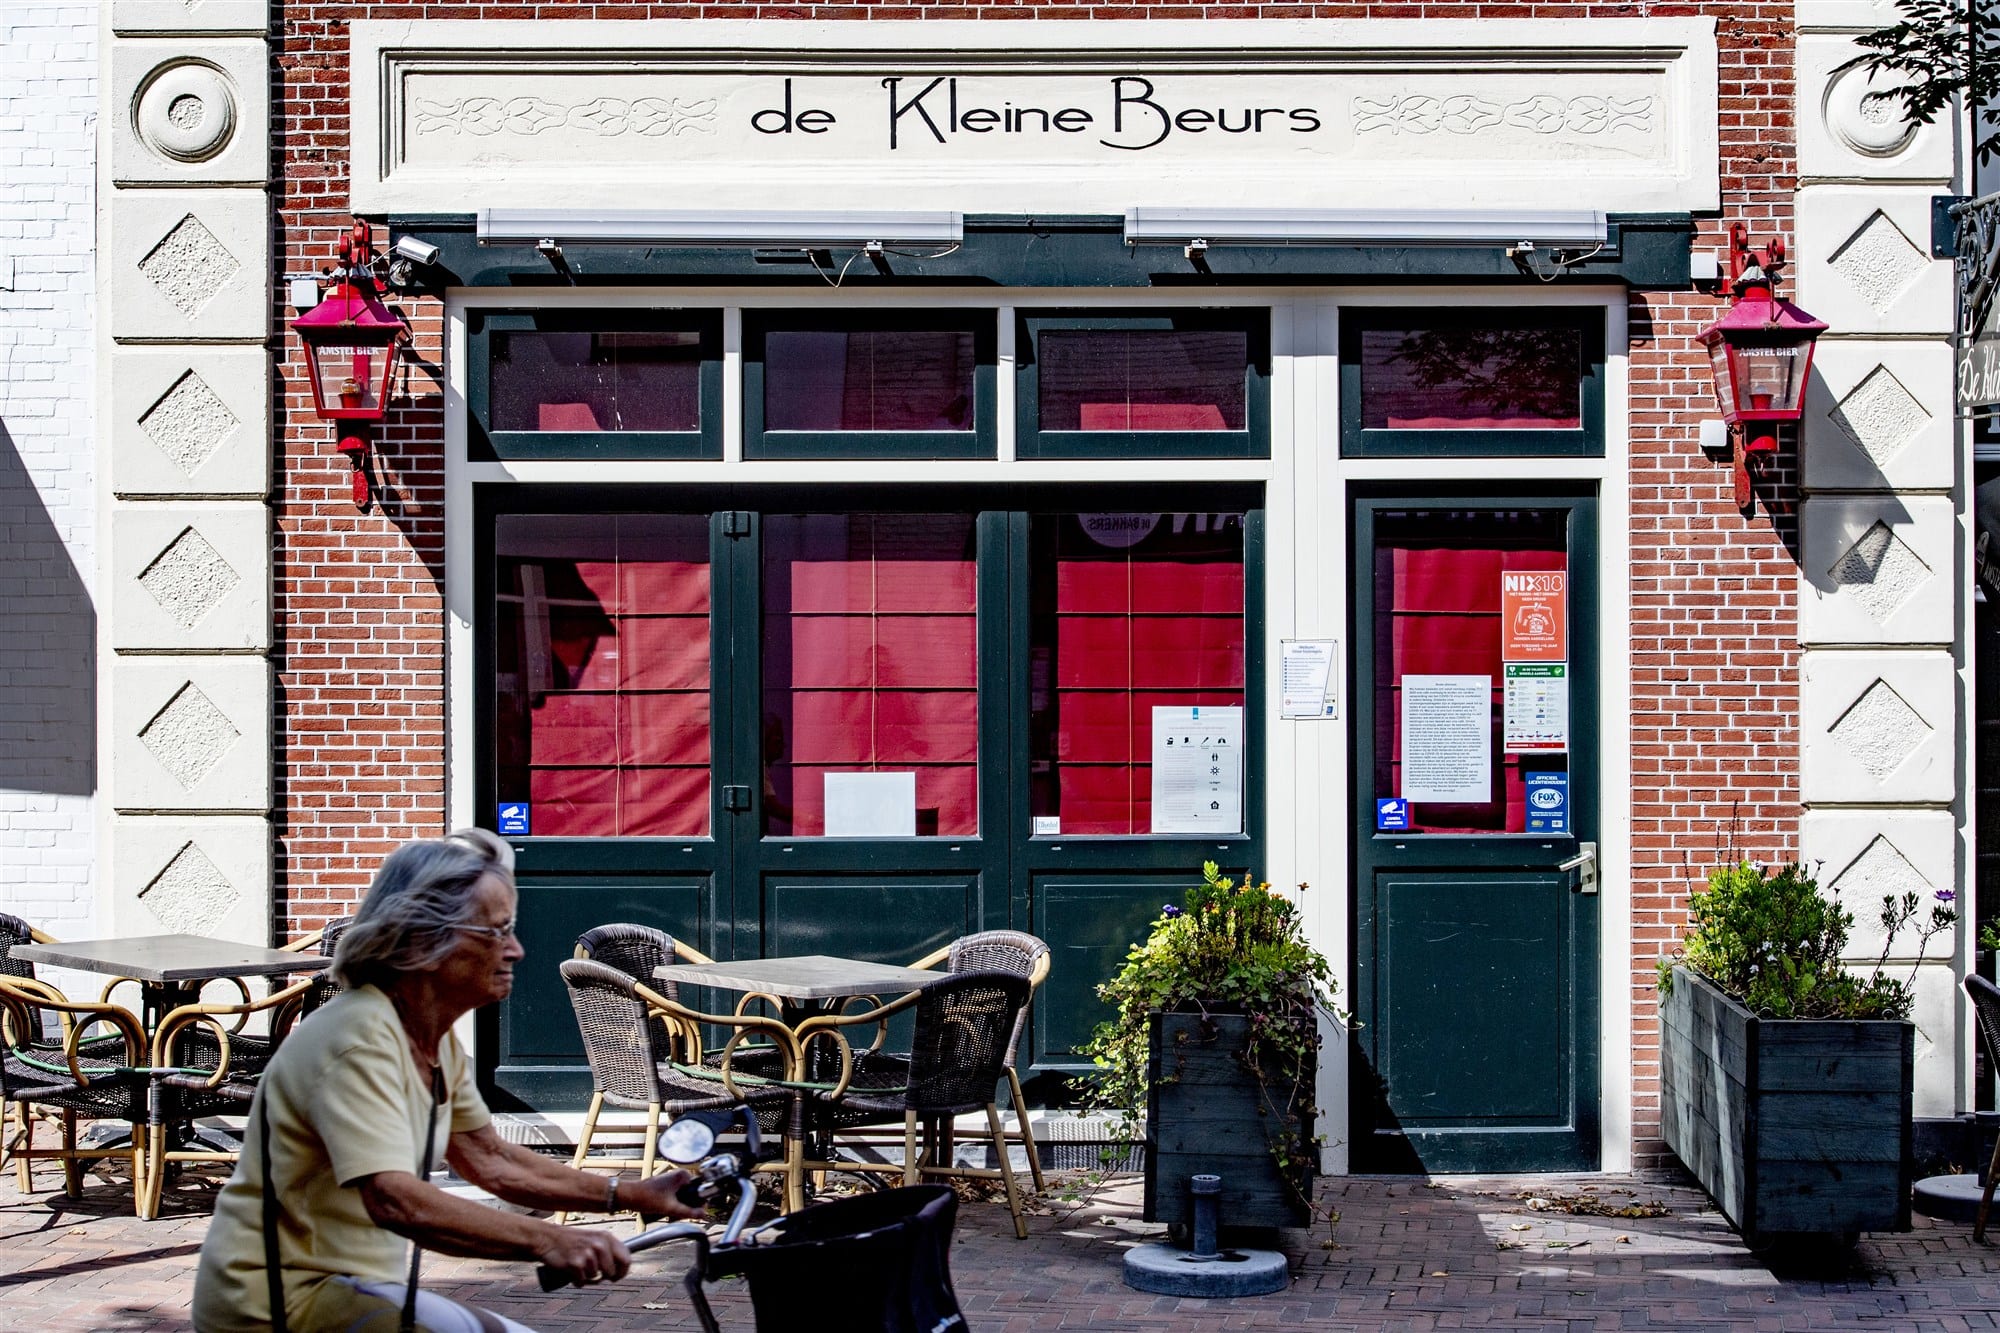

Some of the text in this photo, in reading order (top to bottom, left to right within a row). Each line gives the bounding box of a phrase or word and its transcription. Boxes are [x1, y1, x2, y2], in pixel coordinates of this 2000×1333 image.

[750, 76, 1322, 151] de Kleine Beurs
[319, 345, 379, 355] AMSTEL BIER
[1739, 347, 1799, 357] AMSTEL BIER
[1958, 347, 1979, 402] De
[1505, 575, 1563, 592] NIX18
[1538, 793, 1556, 801] FOX
